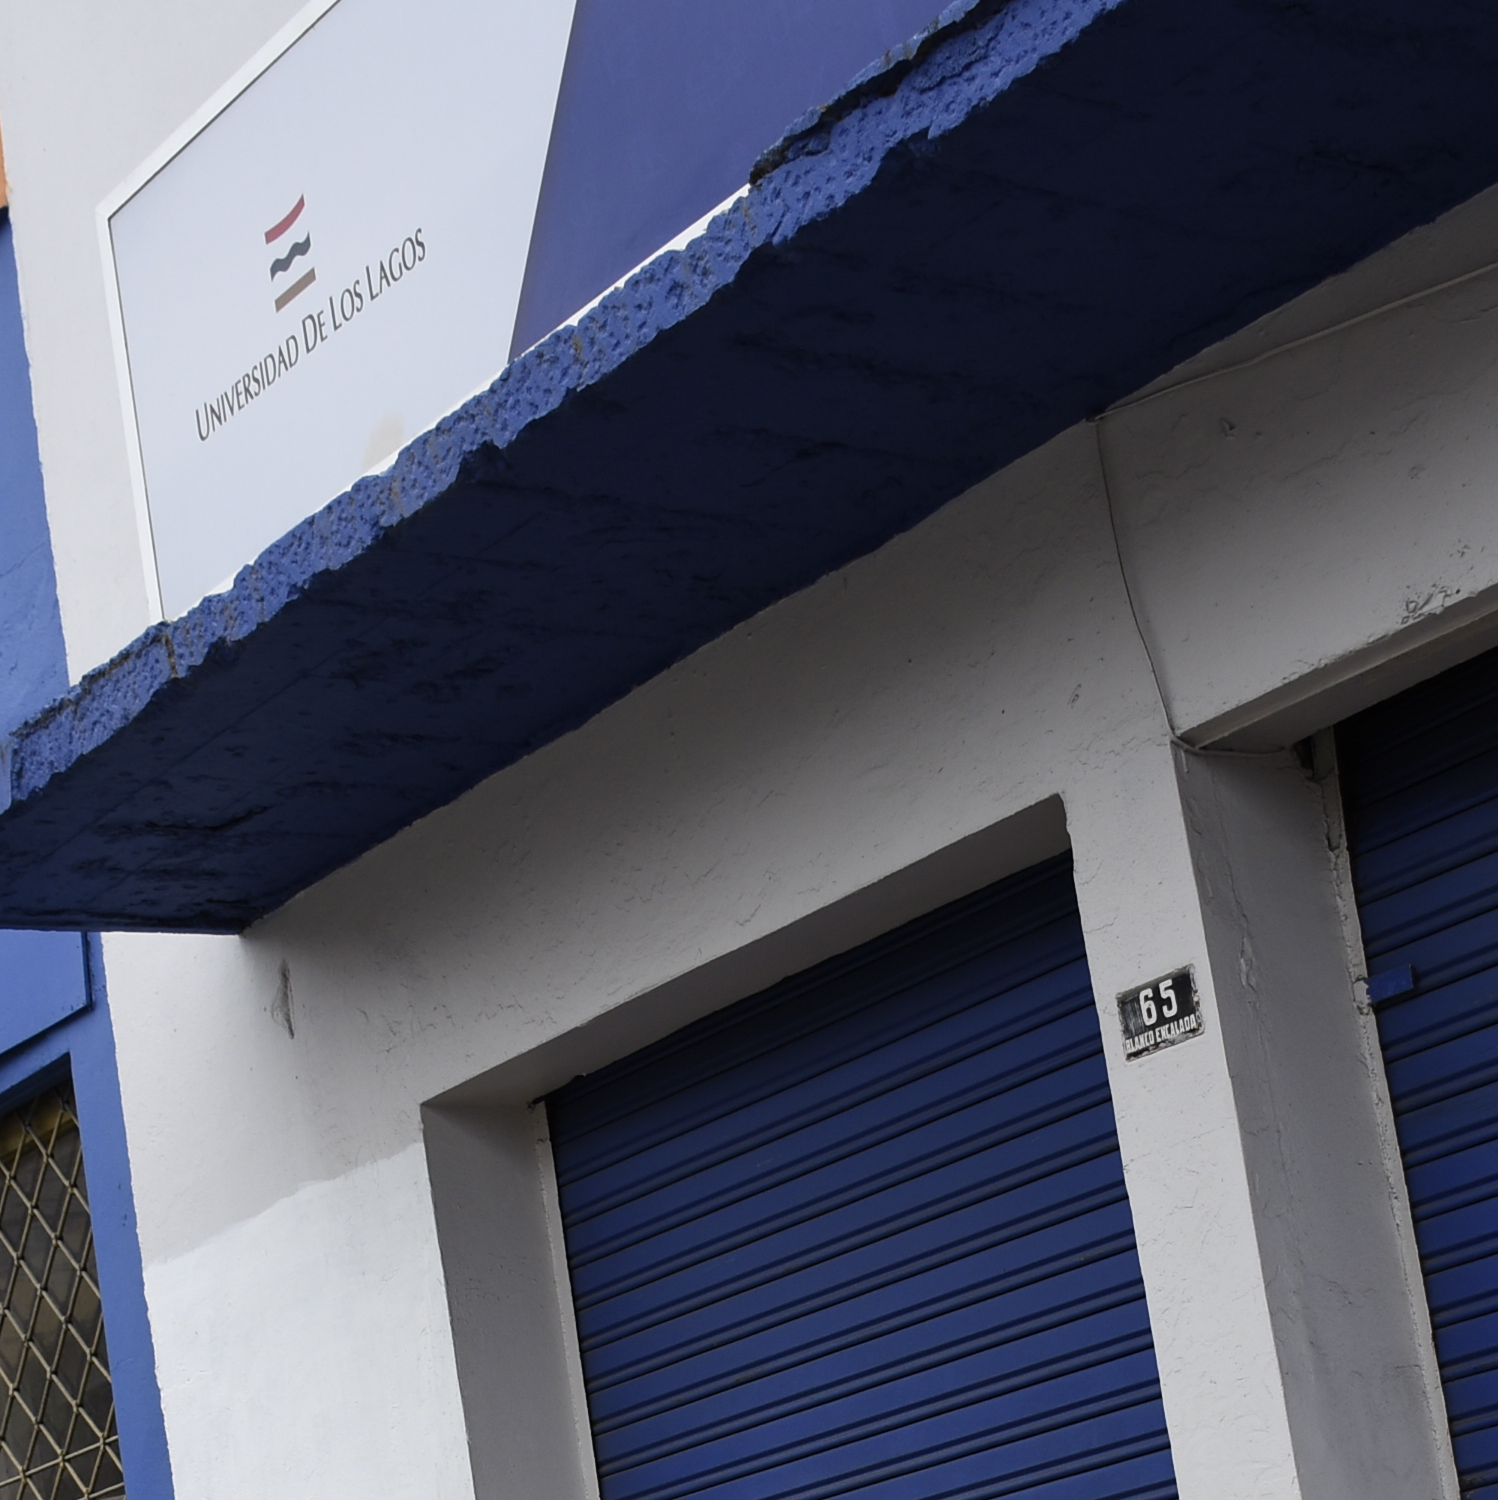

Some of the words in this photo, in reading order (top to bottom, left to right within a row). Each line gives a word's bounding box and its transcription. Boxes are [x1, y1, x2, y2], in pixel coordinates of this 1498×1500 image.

[195, 335, 300, 442] UNIVERSIDAD
[301, 309, 328, 355] DE
[328, 279, 364, 332] LOS
[365, 227, 427, 302] LAGOS
[1139, 979, 1178, 1027] 65
